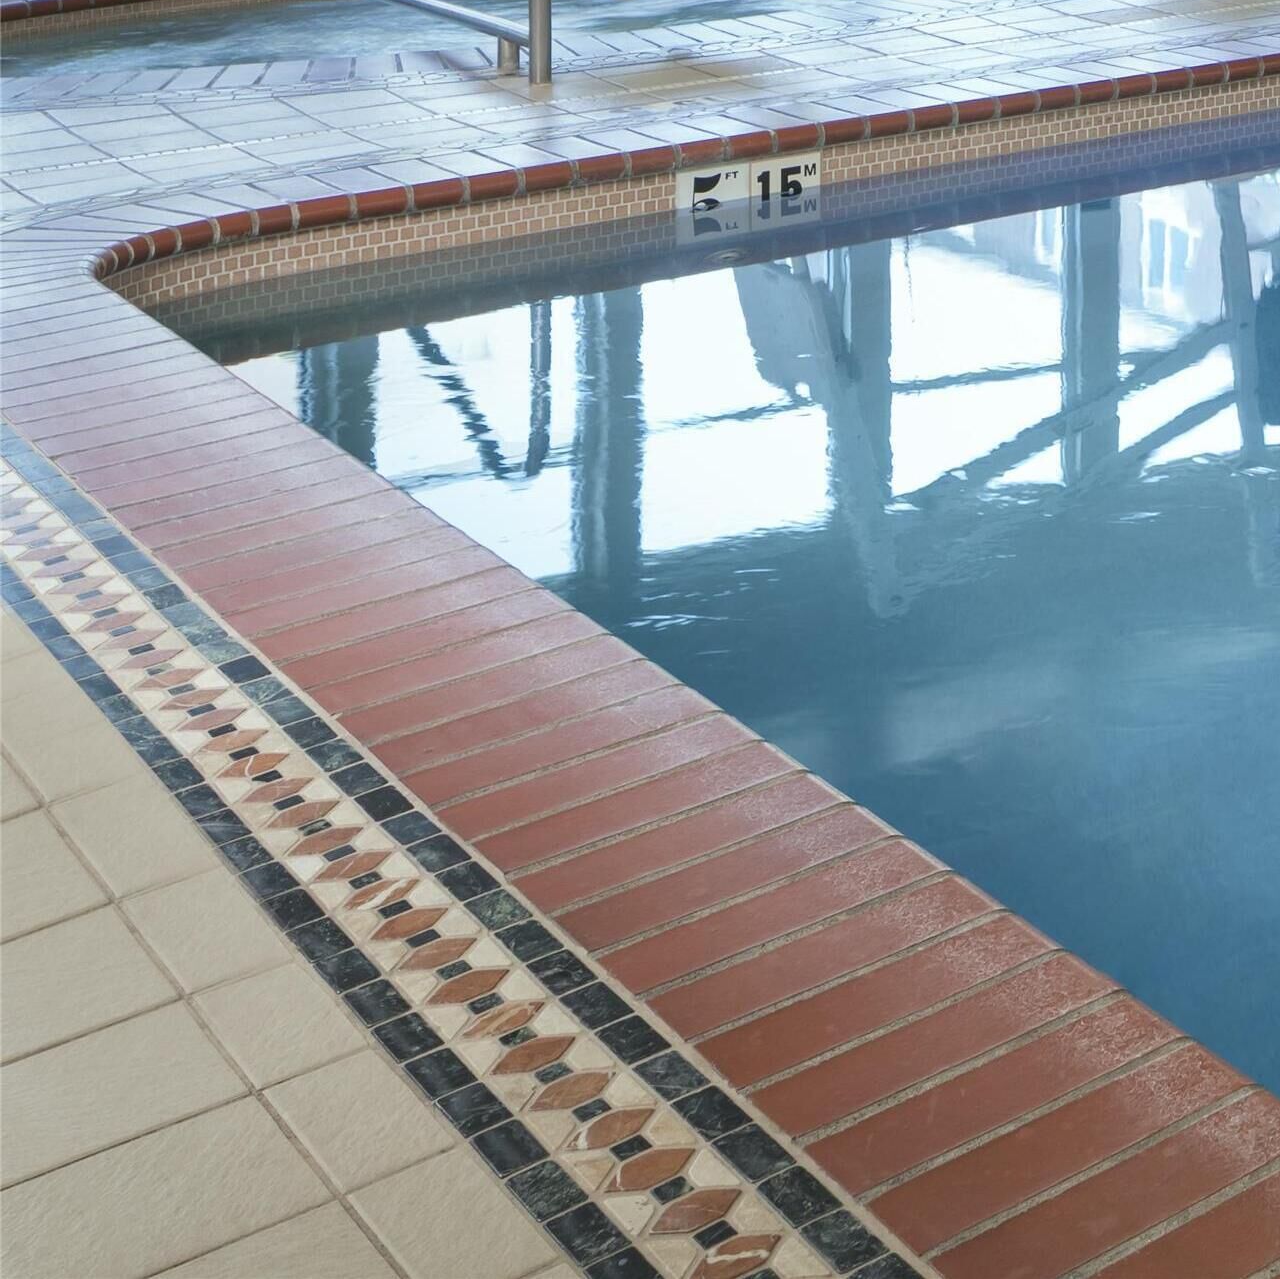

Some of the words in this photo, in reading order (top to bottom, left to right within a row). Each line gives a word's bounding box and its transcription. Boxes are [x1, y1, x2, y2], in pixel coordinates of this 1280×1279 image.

[725, 171, 739, 180] FT
[757, 166, 802, 201] 15
[804, 163, 817, 177] M
